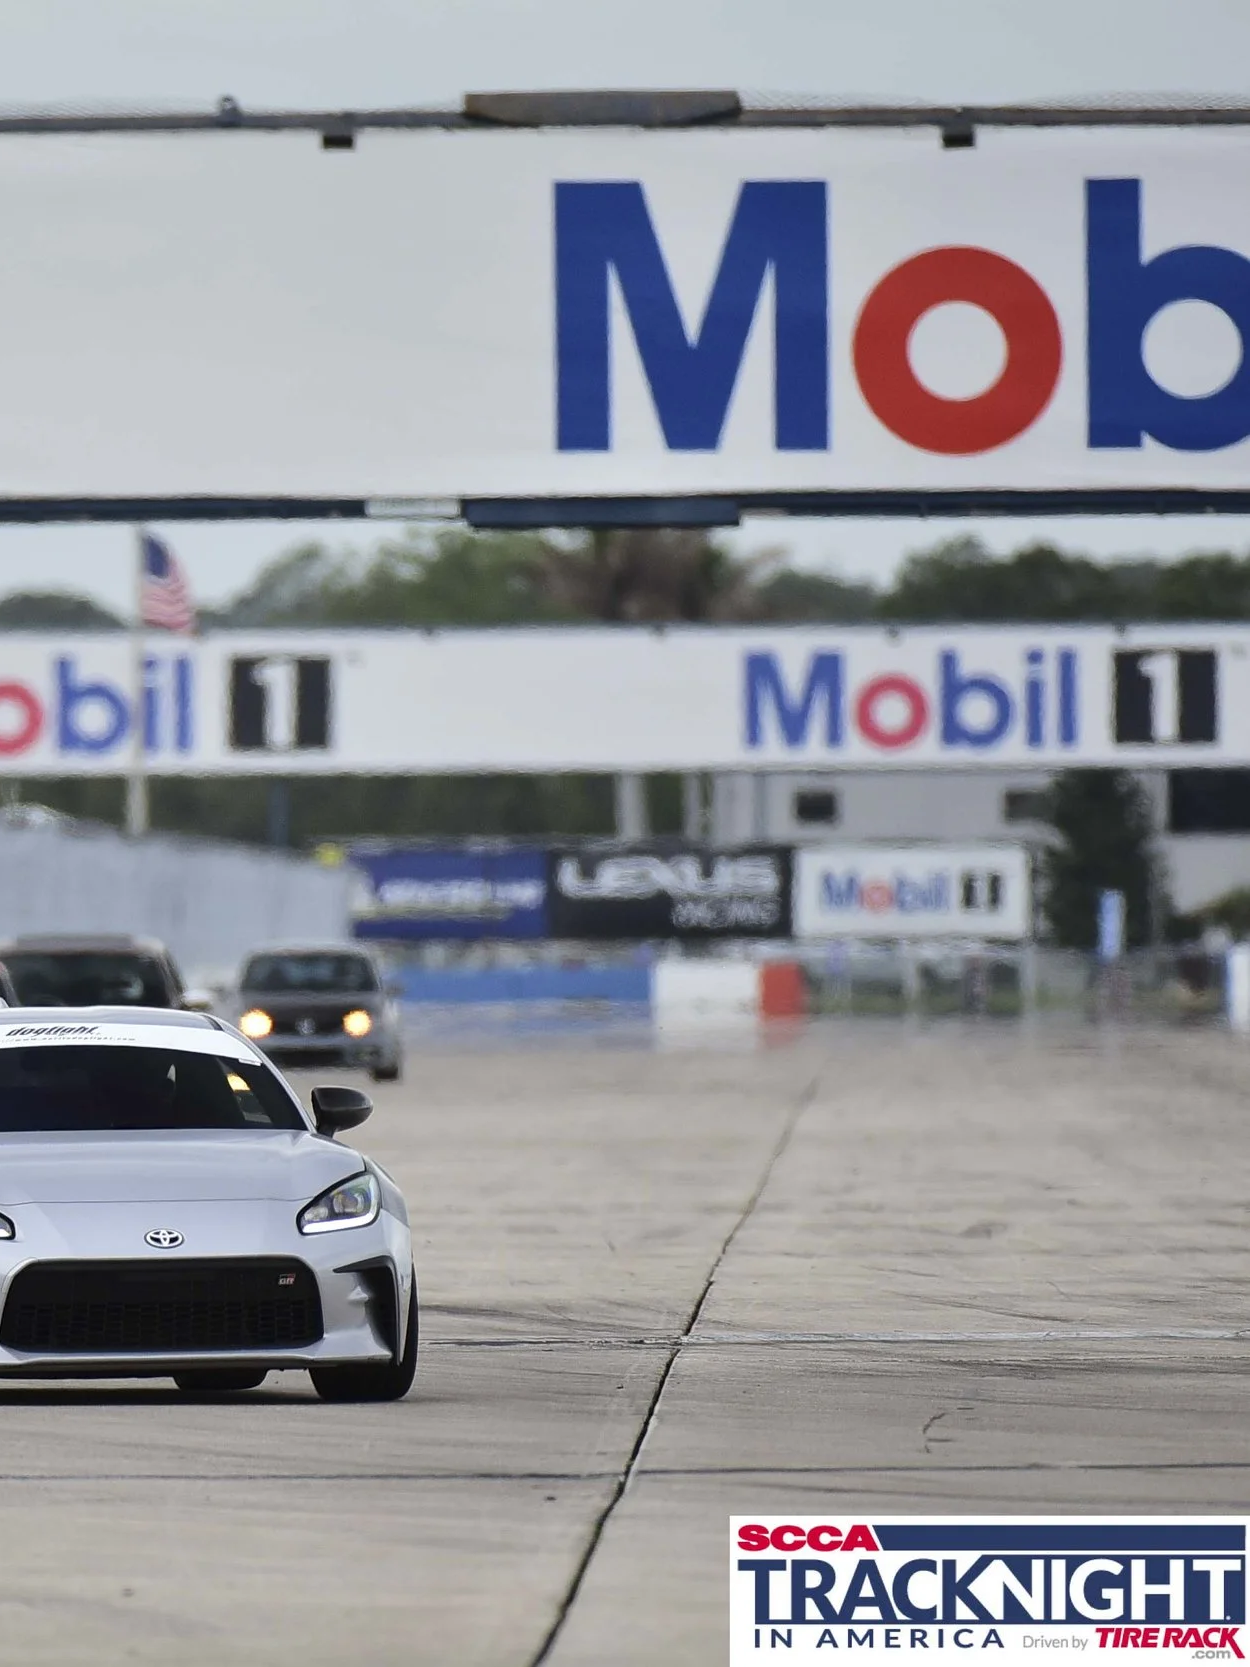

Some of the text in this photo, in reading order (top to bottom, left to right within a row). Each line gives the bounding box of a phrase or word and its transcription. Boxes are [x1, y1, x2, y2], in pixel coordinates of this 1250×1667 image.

[554, 177, 1250, 453] Mob
[741, 648, 1077, 750] Mobil
[556, 856, 778, 899] LEXUS
[819, 871, 948, 912] Mobil
